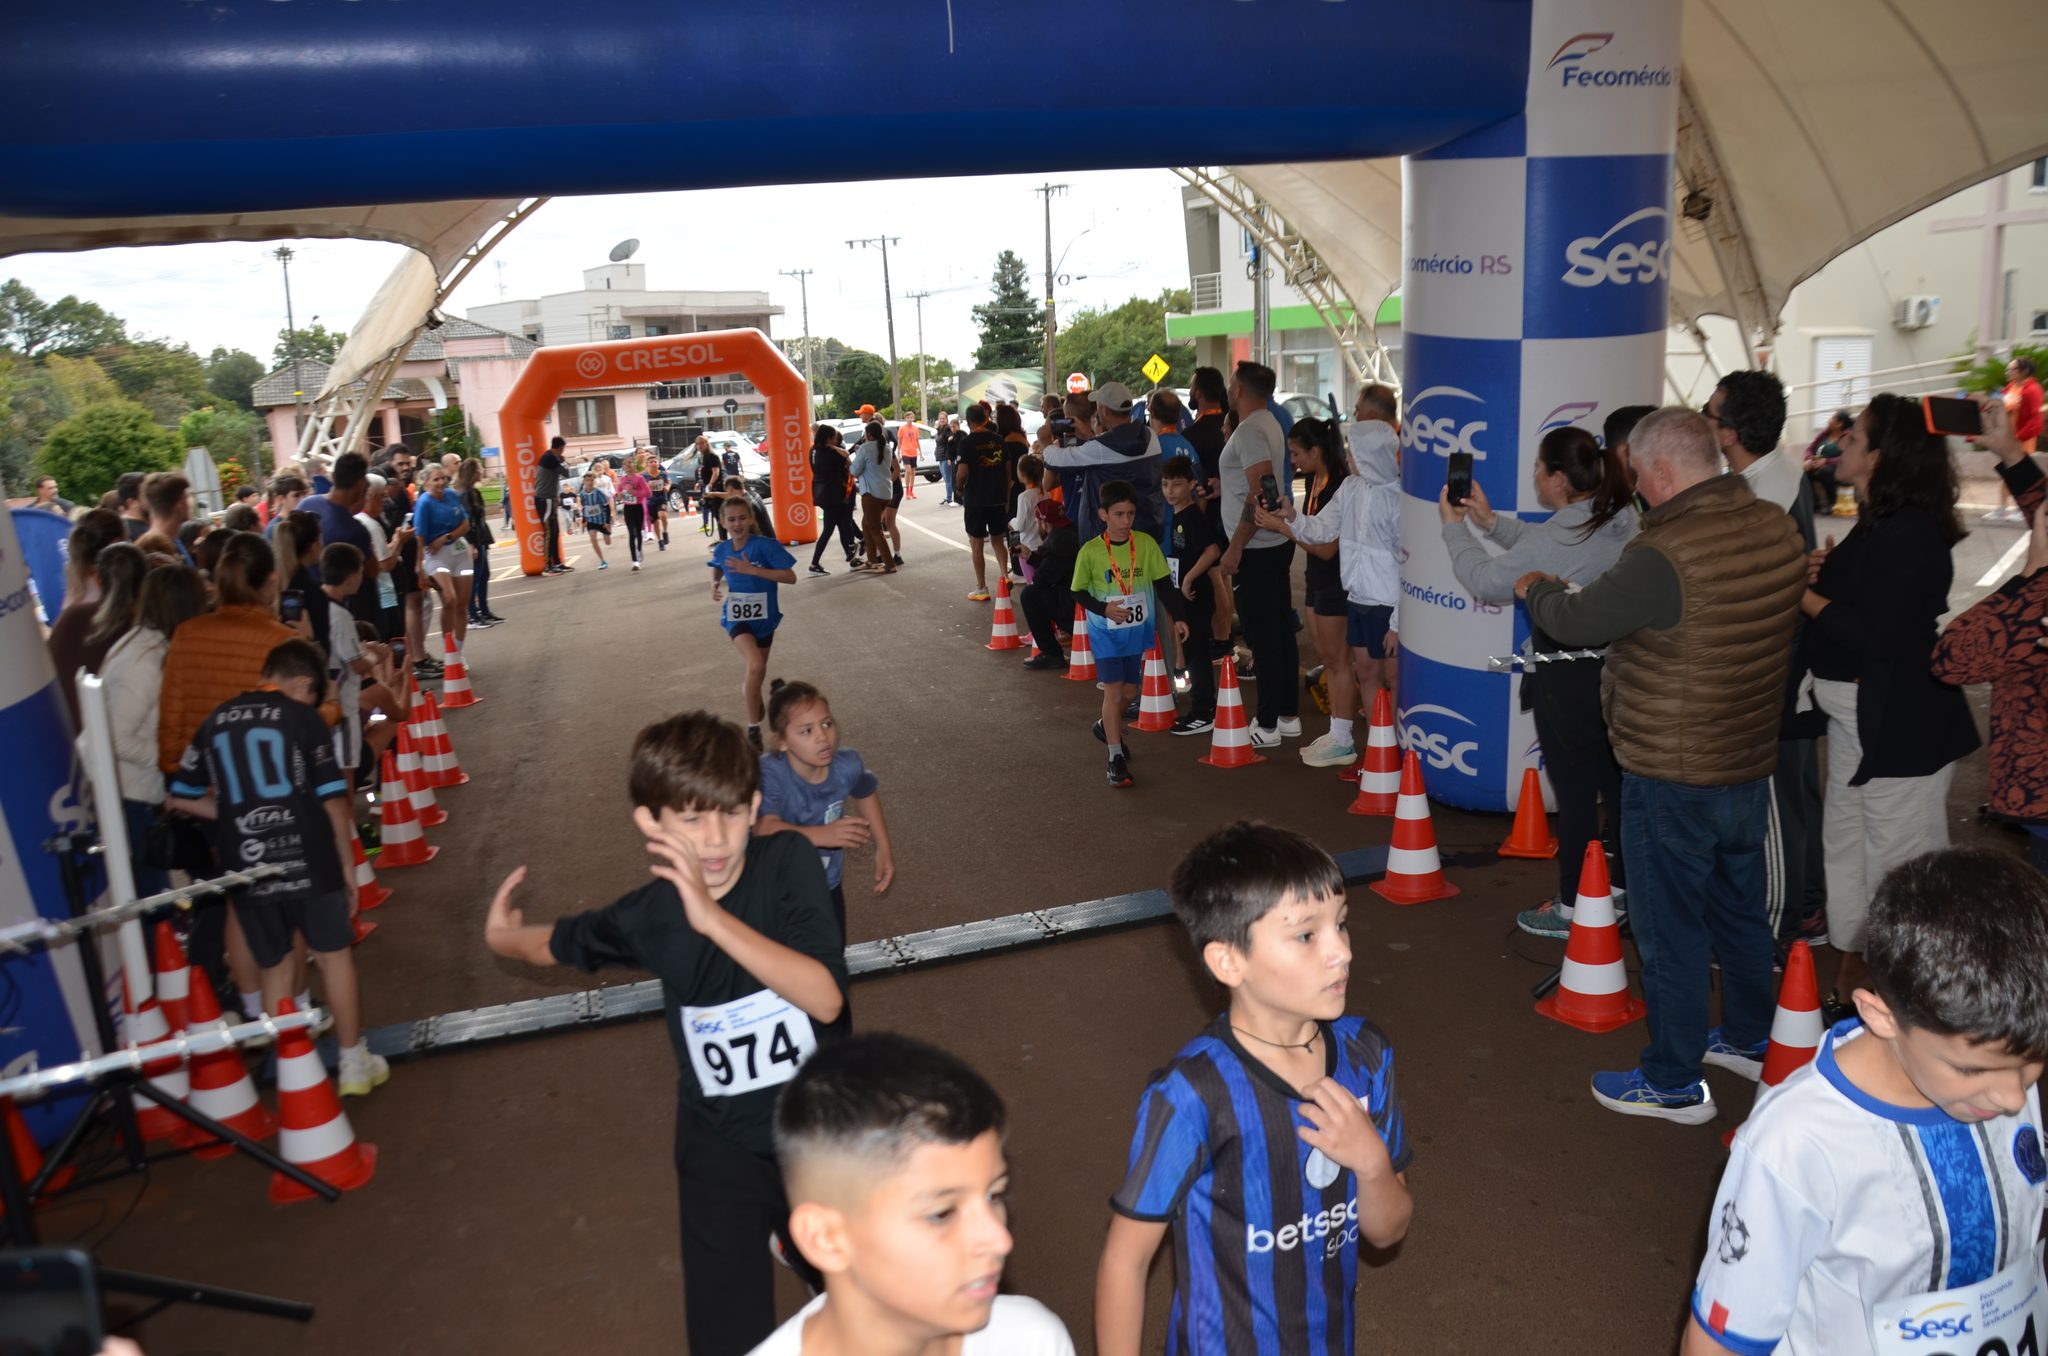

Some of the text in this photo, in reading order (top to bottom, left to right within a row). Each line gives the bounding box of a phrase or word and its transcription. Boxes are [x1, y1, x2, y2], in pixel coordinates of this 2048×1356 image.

[1562, 64, 1671, 87] Fecomércio
[1480, 255, 1513, 275] RS
[614, 342, 724, 372] CRESOL
[783, 407, 805, 496] CRESOL
[732, 603, 763, 619] 982
[216, 708, 254, 725] BOA
[213, 726, 294, 805] 10
[703, 1019, 800, 1086] 974
[1247, 1196, 1358, 1254] betsso
[1898, 1313, 1974, 1340] Sesc
